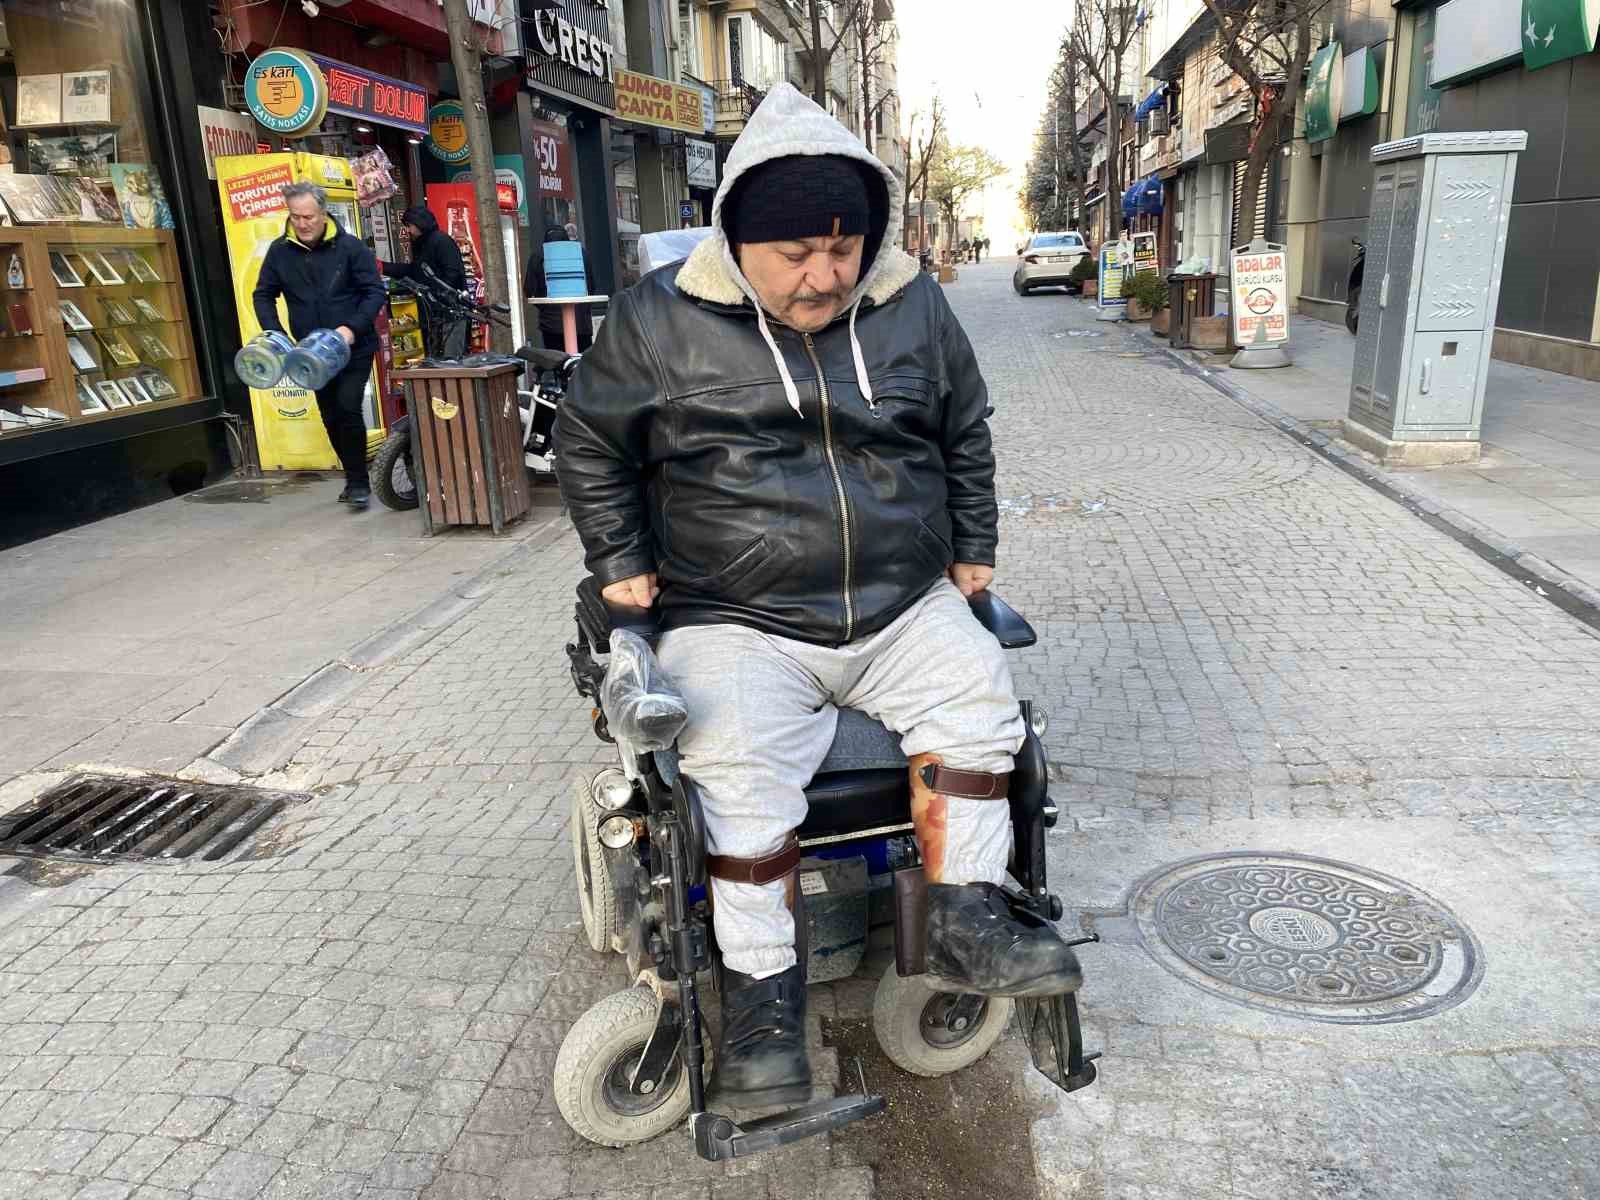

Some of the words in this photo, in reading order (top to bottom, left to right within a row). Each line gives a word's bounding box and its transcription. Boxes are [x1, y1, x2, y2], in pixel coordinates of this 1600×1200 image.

[614, 72, 673, 101] LUMOS
[253, 104, 276, 127] SATIŞ
[278, 104, 311, 128] NOKTASI
[374, 82, 425, 123] DOLUM
[616, 94, 674, 122] ÇANTA
